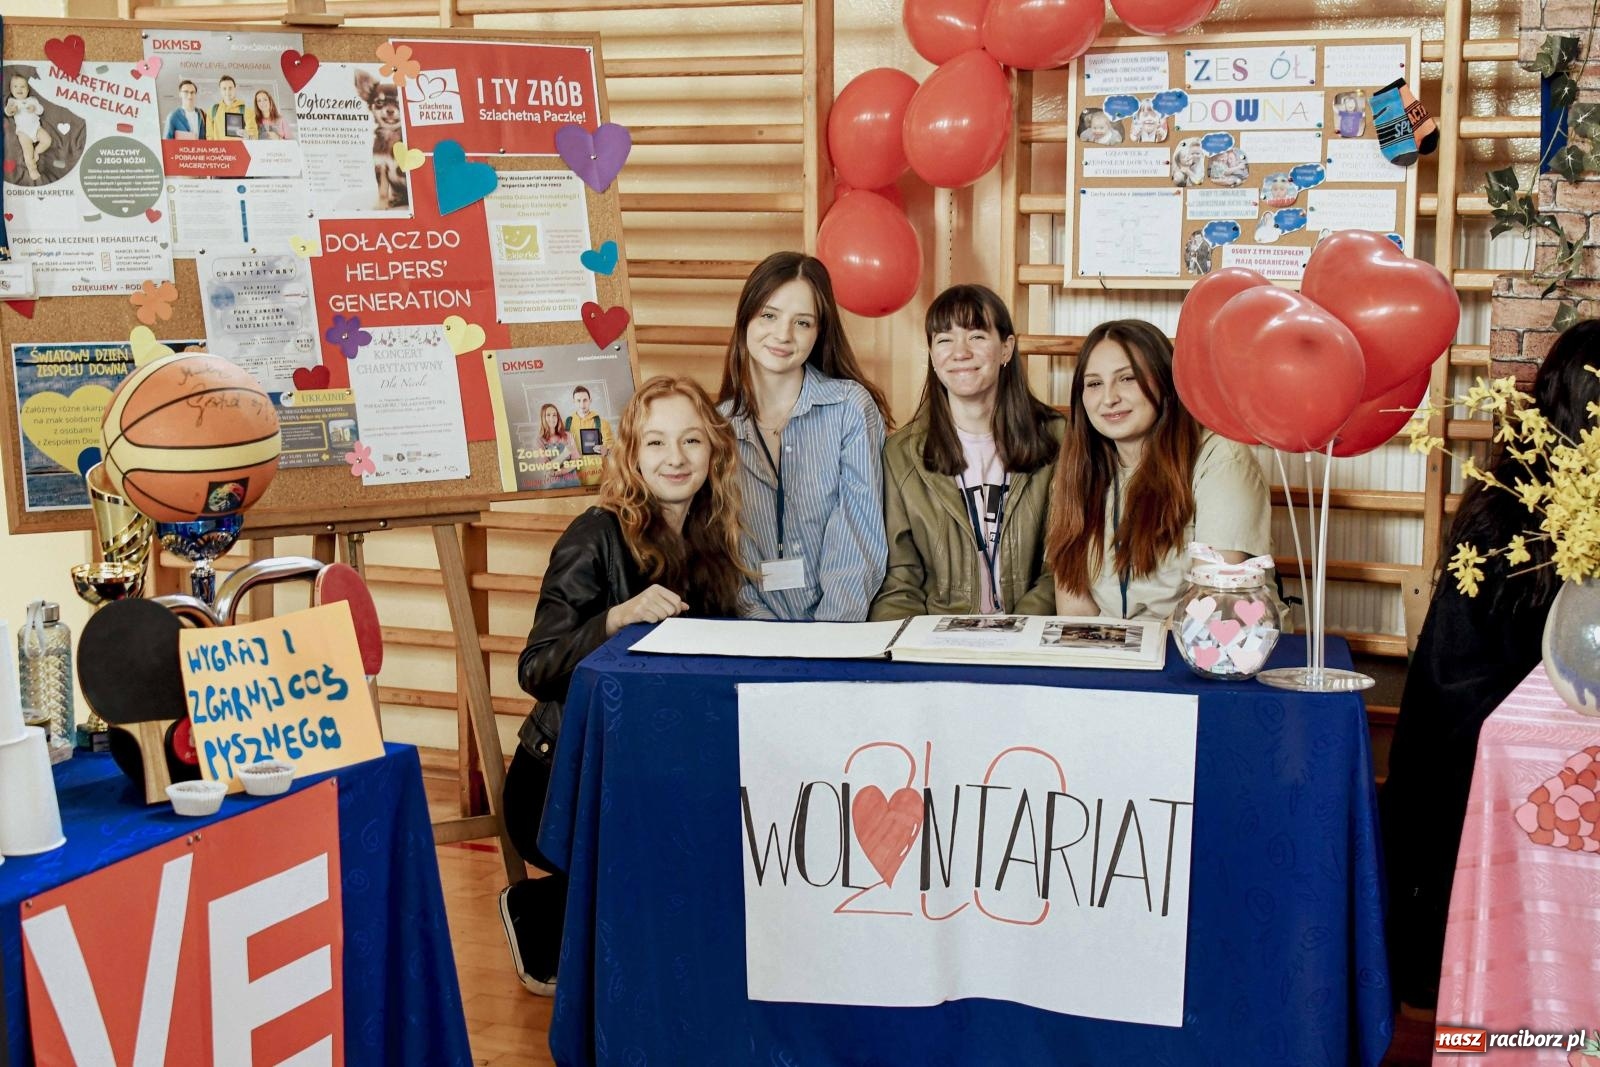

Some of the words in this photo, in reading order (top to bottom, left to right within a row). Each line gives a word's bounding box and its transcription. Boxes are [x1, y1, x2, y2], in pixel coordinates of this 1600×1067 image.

[152, 39, 190, 50] DKMS
[123, 87, 152, 104] DLA
[477, 78, 484, 104] I
[491, 78, 519, 104] TY
[527, 75, 583, 107] ZRÓB
[56, 86, 139, 119] MARCELKA!
[297, 92, 362, 114] Ogłoszenie
[297, 112, 369, 121] WOLONTARIATU
[419, 111, 454, 121] PACZKA
[479, 108, 541, 124] Szlachetną
[544, 110, 586, 125] Paczkę!
[1189, 98, 1309, 123] DOWNA
[99, 149, 140, 157] WALCZYMY
[6, 188, 35, 196] ODBIÓR
[37, 189, 75, 197] NAKRĘTEK
[58, 236, 95, 244] LECZENIE
[100, 236, 158, 245] REHABILITACJĘ
[325, 231, 422, 254] DOŁĄCZ
[426, 230, 460, 249] DO
[71, 284, 118, 292] DZIĘKUJEMY
[329, 289, 472, 313] GENERATION
[30, 346, 90, 363] ŚWIATOWY
[95, 345, 129, 362] DZIEŃ
[373, 348, 423, 360] KONCERT
[37, 363, 83, 377] ZESPOŁU
[89, 363, 128, 375] DOWNA
[356, 360, 444, 375] CHARYTATYWNY
[502, 360, 534, 372] DKMS
[25, 405, 57, 414] Załóżmy
[59, 405, 81, 413] różne
[45, 416, 63, 424] znak
[43, 438, 81, 447] Zespołem
[517, 447, 560, 460] Zostań
[519, 459, 561, 473] Dawcą
[563, 456, 603, 470] szpiku
[187, 636, 269, 674] WYGRAJ
[282, 629, 295, 654] I
[188, 677, 285, 724] ZGARNIJ
[288, 664, 348, 700] COŚ
[204, 715, 342, 780] PYSZNEGO
[21, 852, 333, 1067] VE
